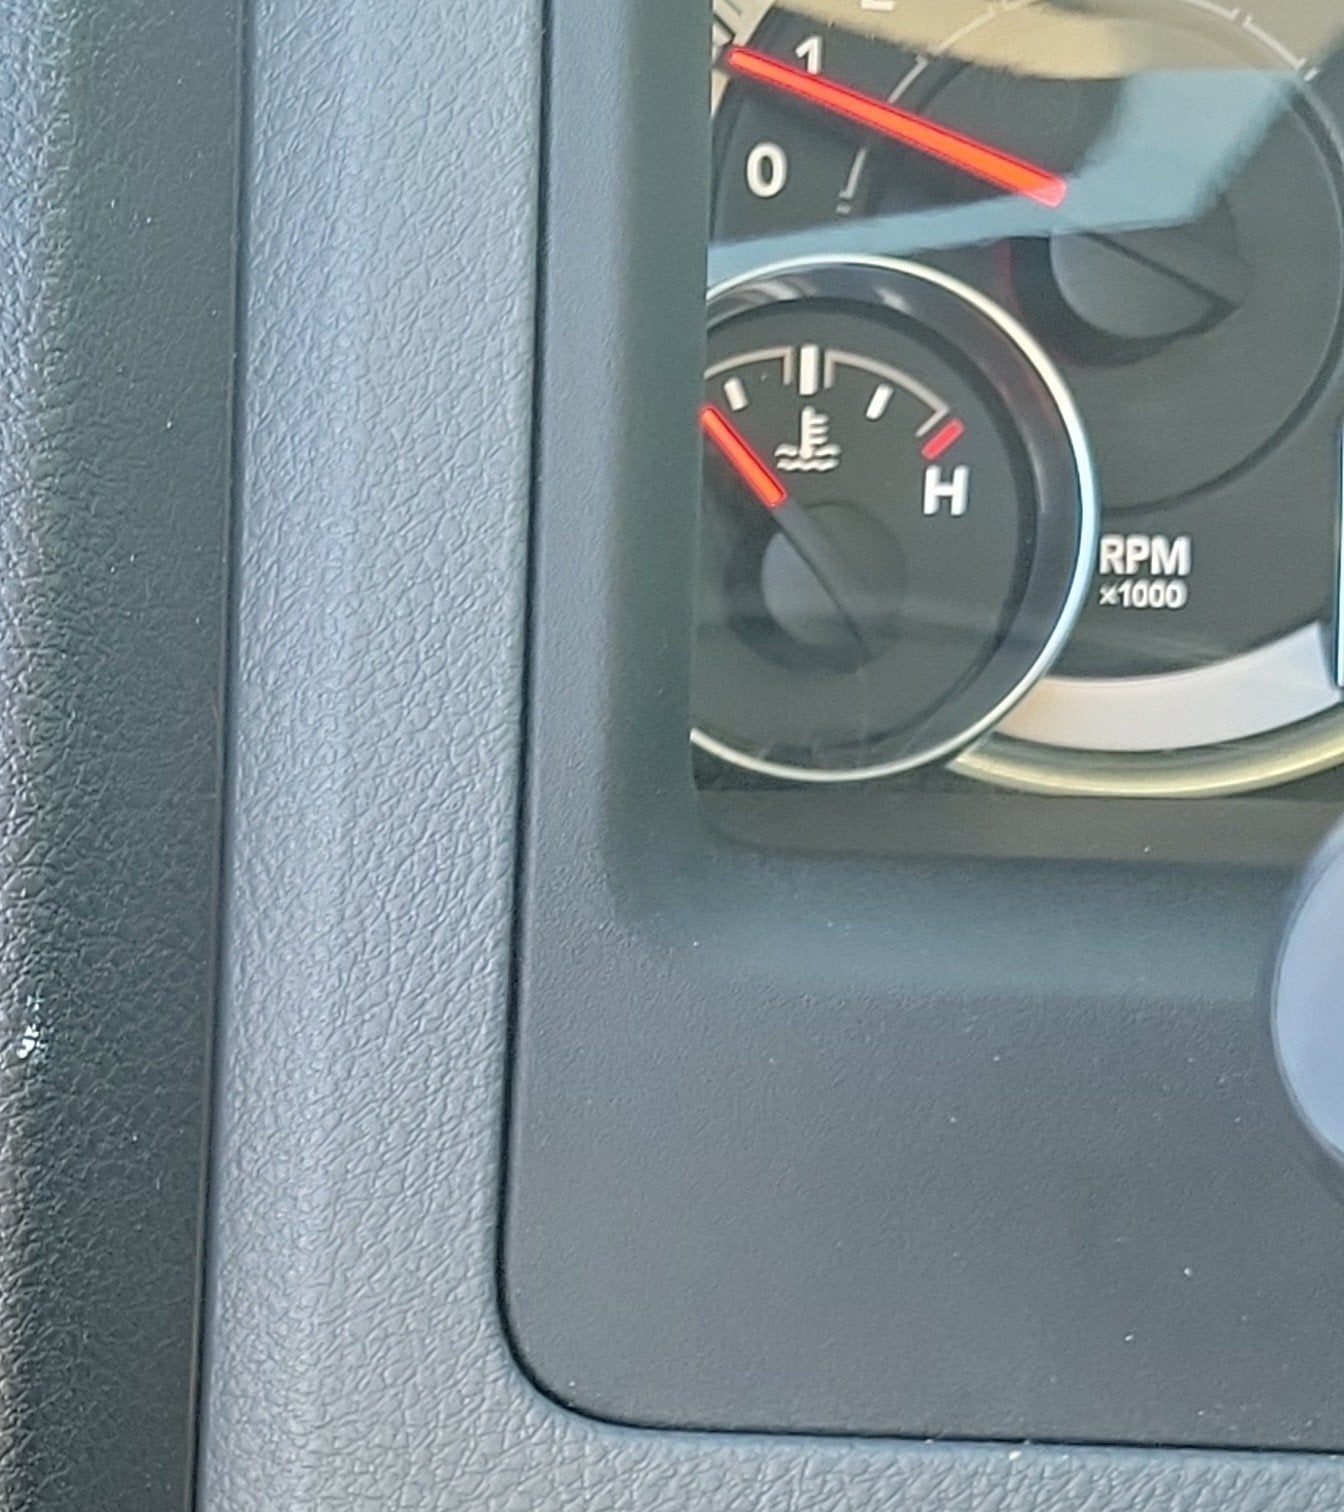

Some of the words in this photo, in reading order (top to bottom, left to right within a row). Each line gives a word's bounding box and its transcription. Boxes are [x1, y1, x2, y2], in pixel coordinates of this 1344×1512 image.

[795, 35, 822, 76] 1
[746, 142, 788, 198] 0
[923, 465, 969, 516] H
[1099, 534, 1191, 576] RPM
